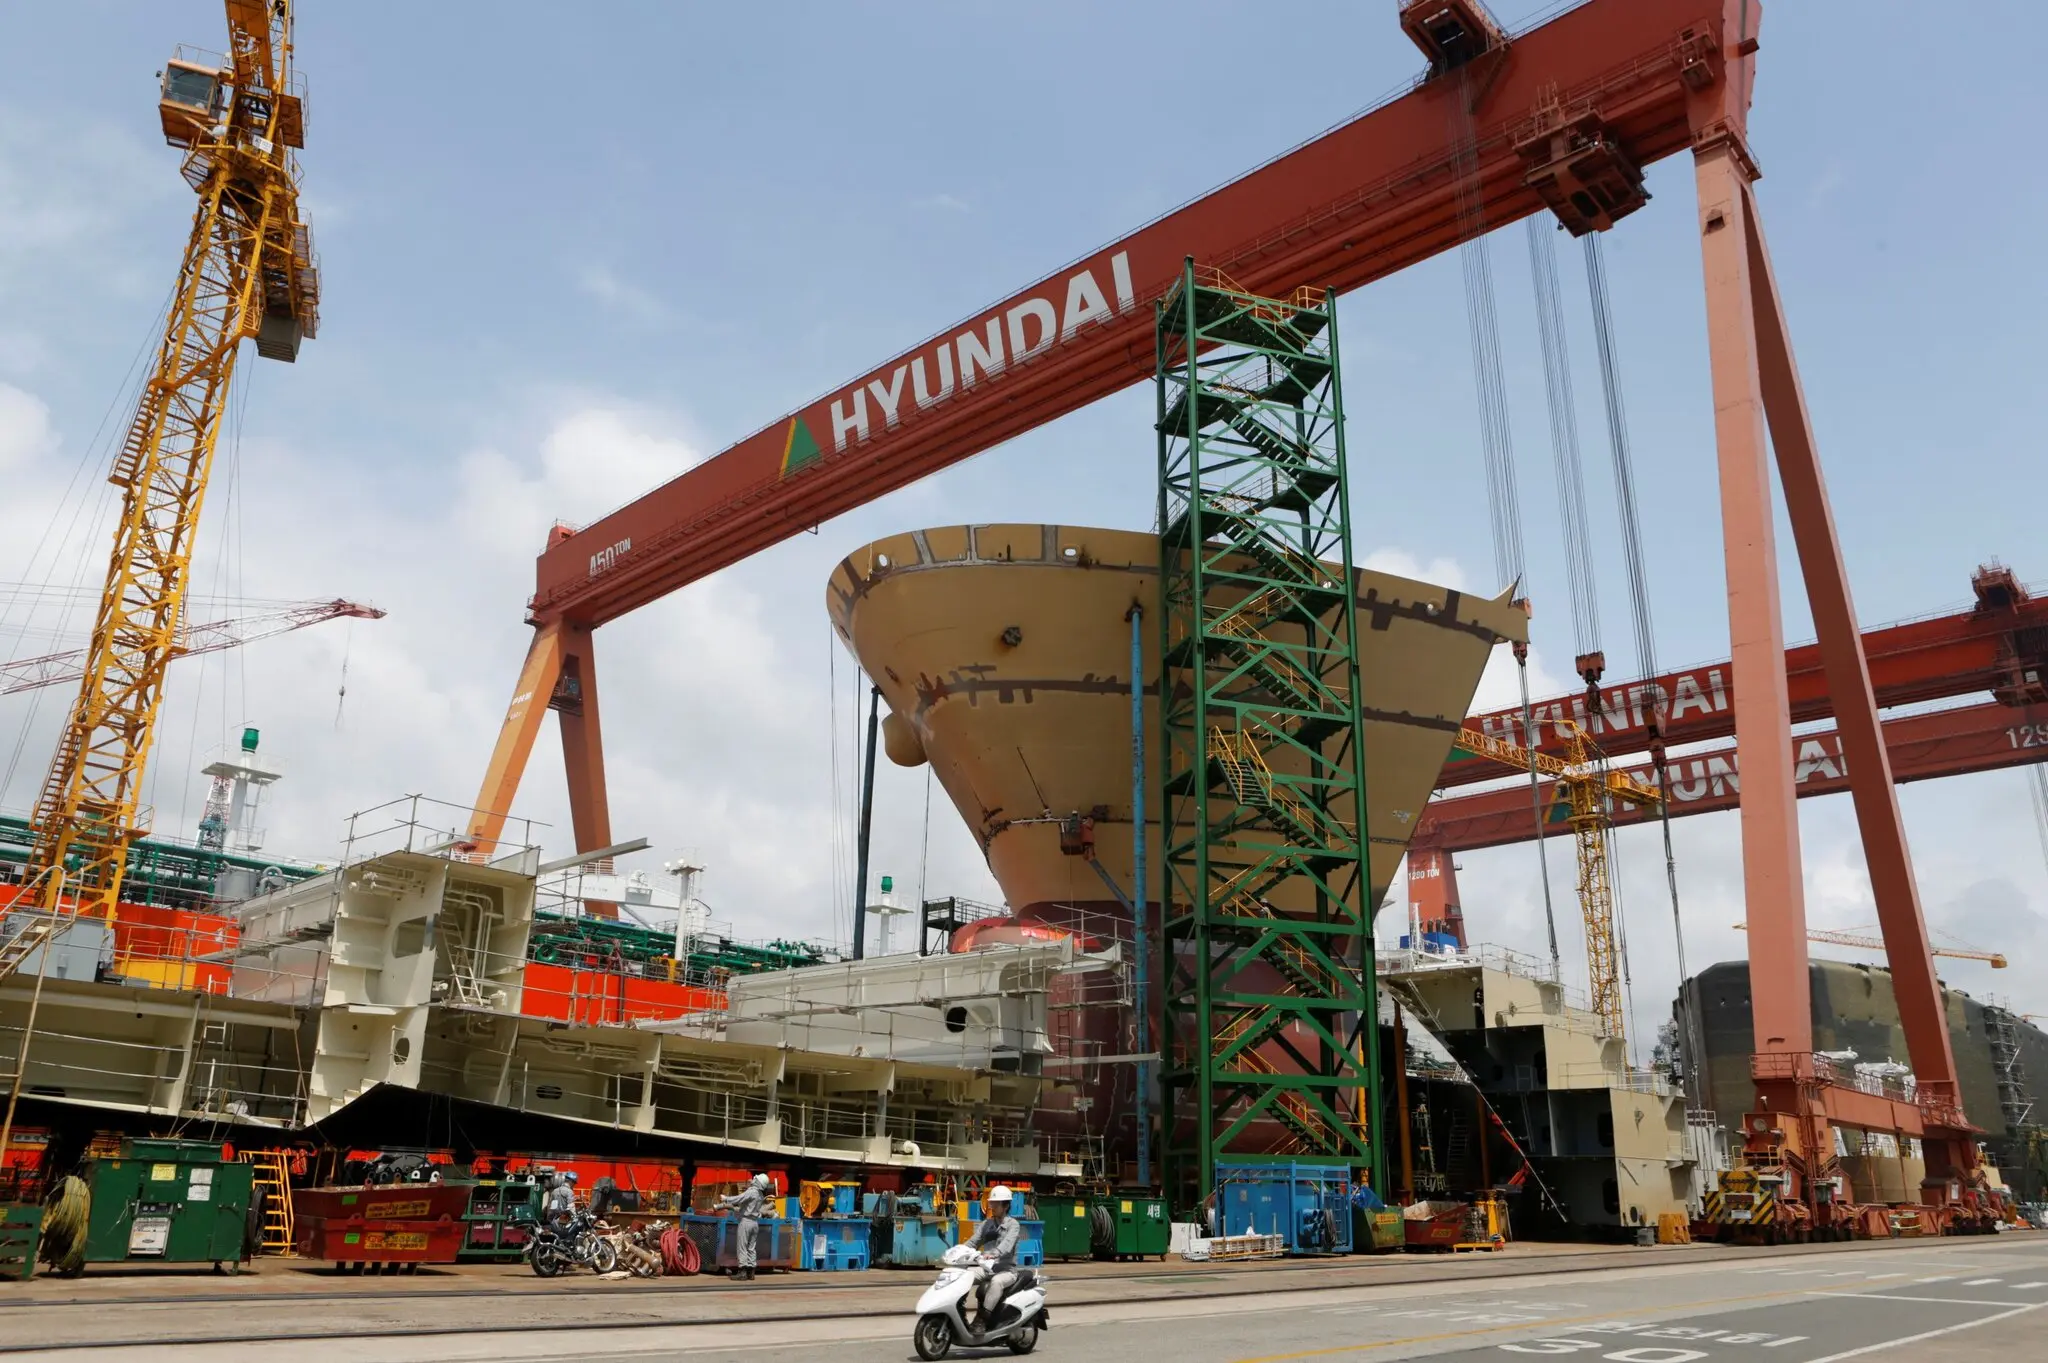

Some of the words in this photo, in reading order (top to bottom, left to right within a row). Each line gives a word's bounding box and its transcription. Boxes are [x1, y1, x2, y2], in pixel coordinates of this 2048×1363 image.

[830, 250, 1136, 453] HYUNDAI
[589, 547, 615, 578] 450
[614, 537, 631, 556] TON
[1427, 868, 1440, 878] TON
[1498, 1338, 1710, 1363] 30
